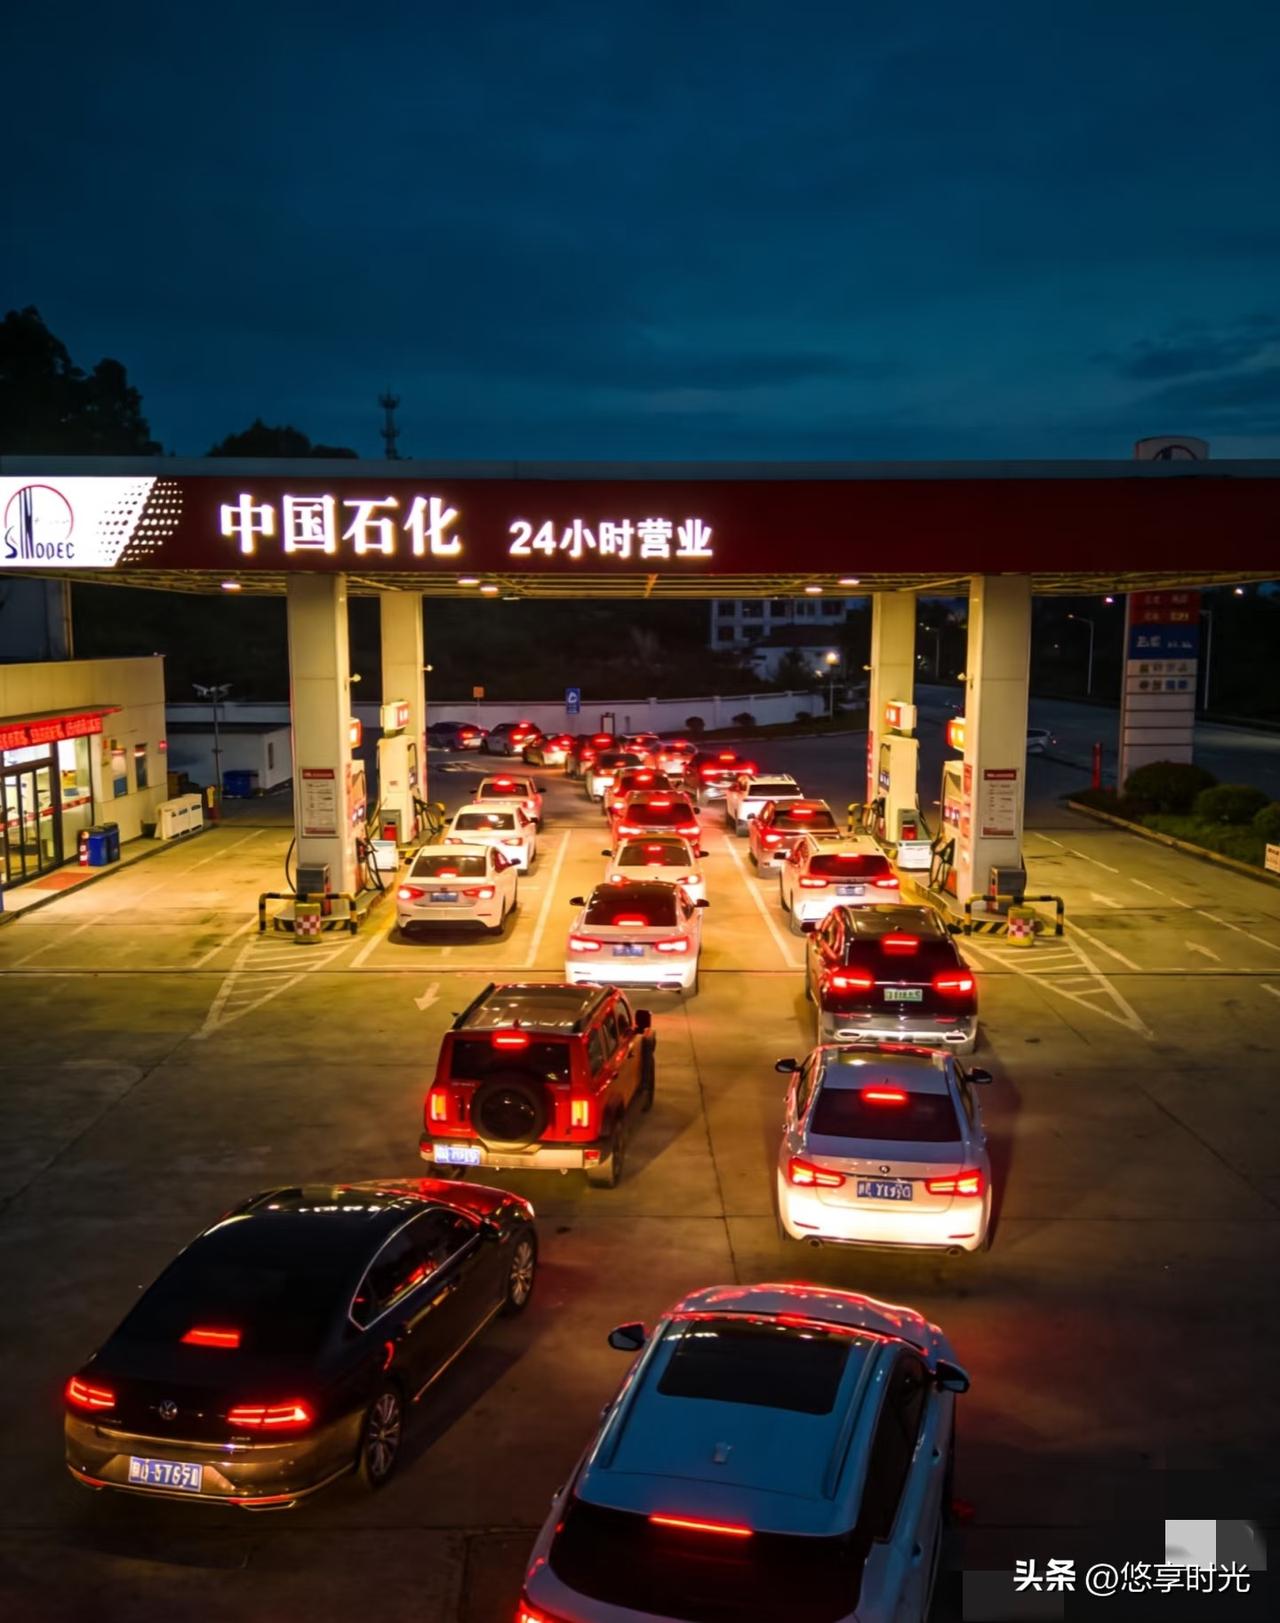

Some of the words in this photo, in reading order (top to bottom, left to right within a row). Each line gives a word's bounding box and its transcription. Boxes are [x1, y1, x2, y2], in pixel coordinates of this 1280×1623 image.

[219, 492, 462, 557] 中国石化
[508, 517, 714, 560] 24小时营业
